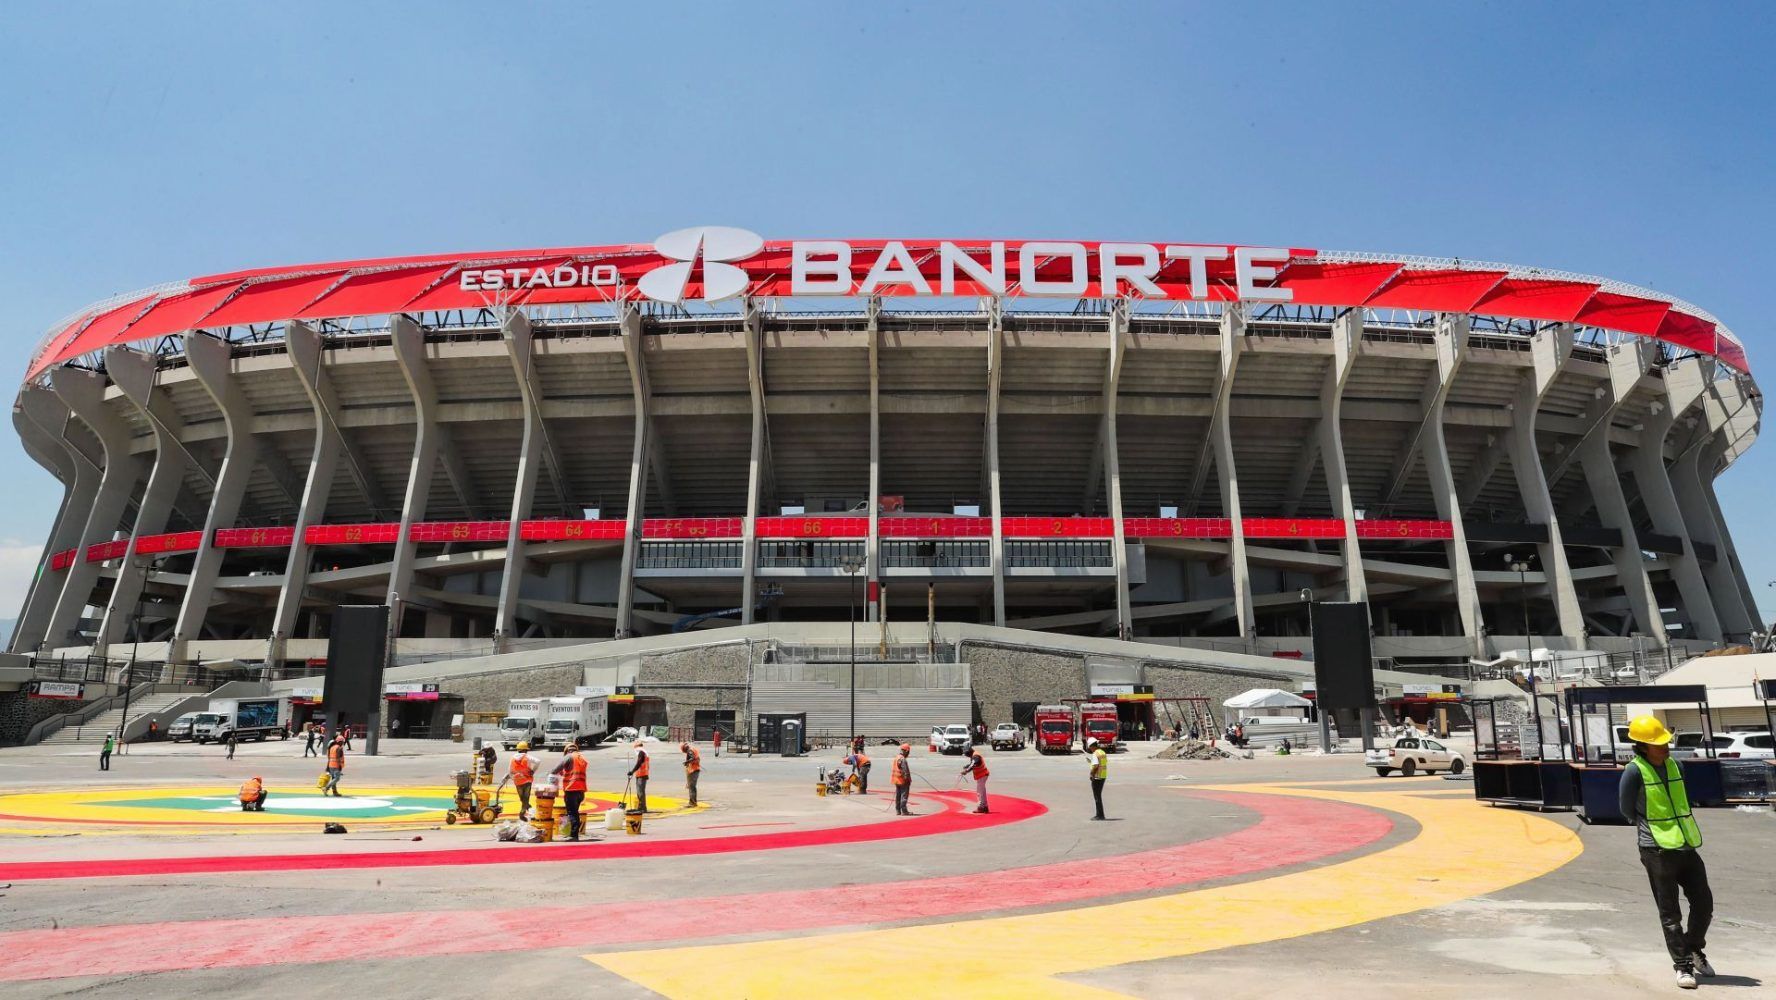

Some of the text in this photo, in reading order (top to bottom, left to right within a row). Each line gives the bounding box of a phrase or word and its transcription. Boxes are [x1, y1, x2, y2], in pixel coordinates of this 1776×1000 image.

[459, 240, 1294, 302] ESTADIO BANORTE
[452, 525, 470, 538] 63
[565, 525, 583, 537] 64
[803, 521, 821, 534] 66
[931, 521, 939, 534] 1
[1054, 521, 1062, 534] 2
[1173, 522, 1182, 534] 3
[1289, 523, 1297, 534] 4
[1400, 523, 1408, 536] 5
[251, 531, 267, 544] 61
[345, 528, 362, 541] 62
